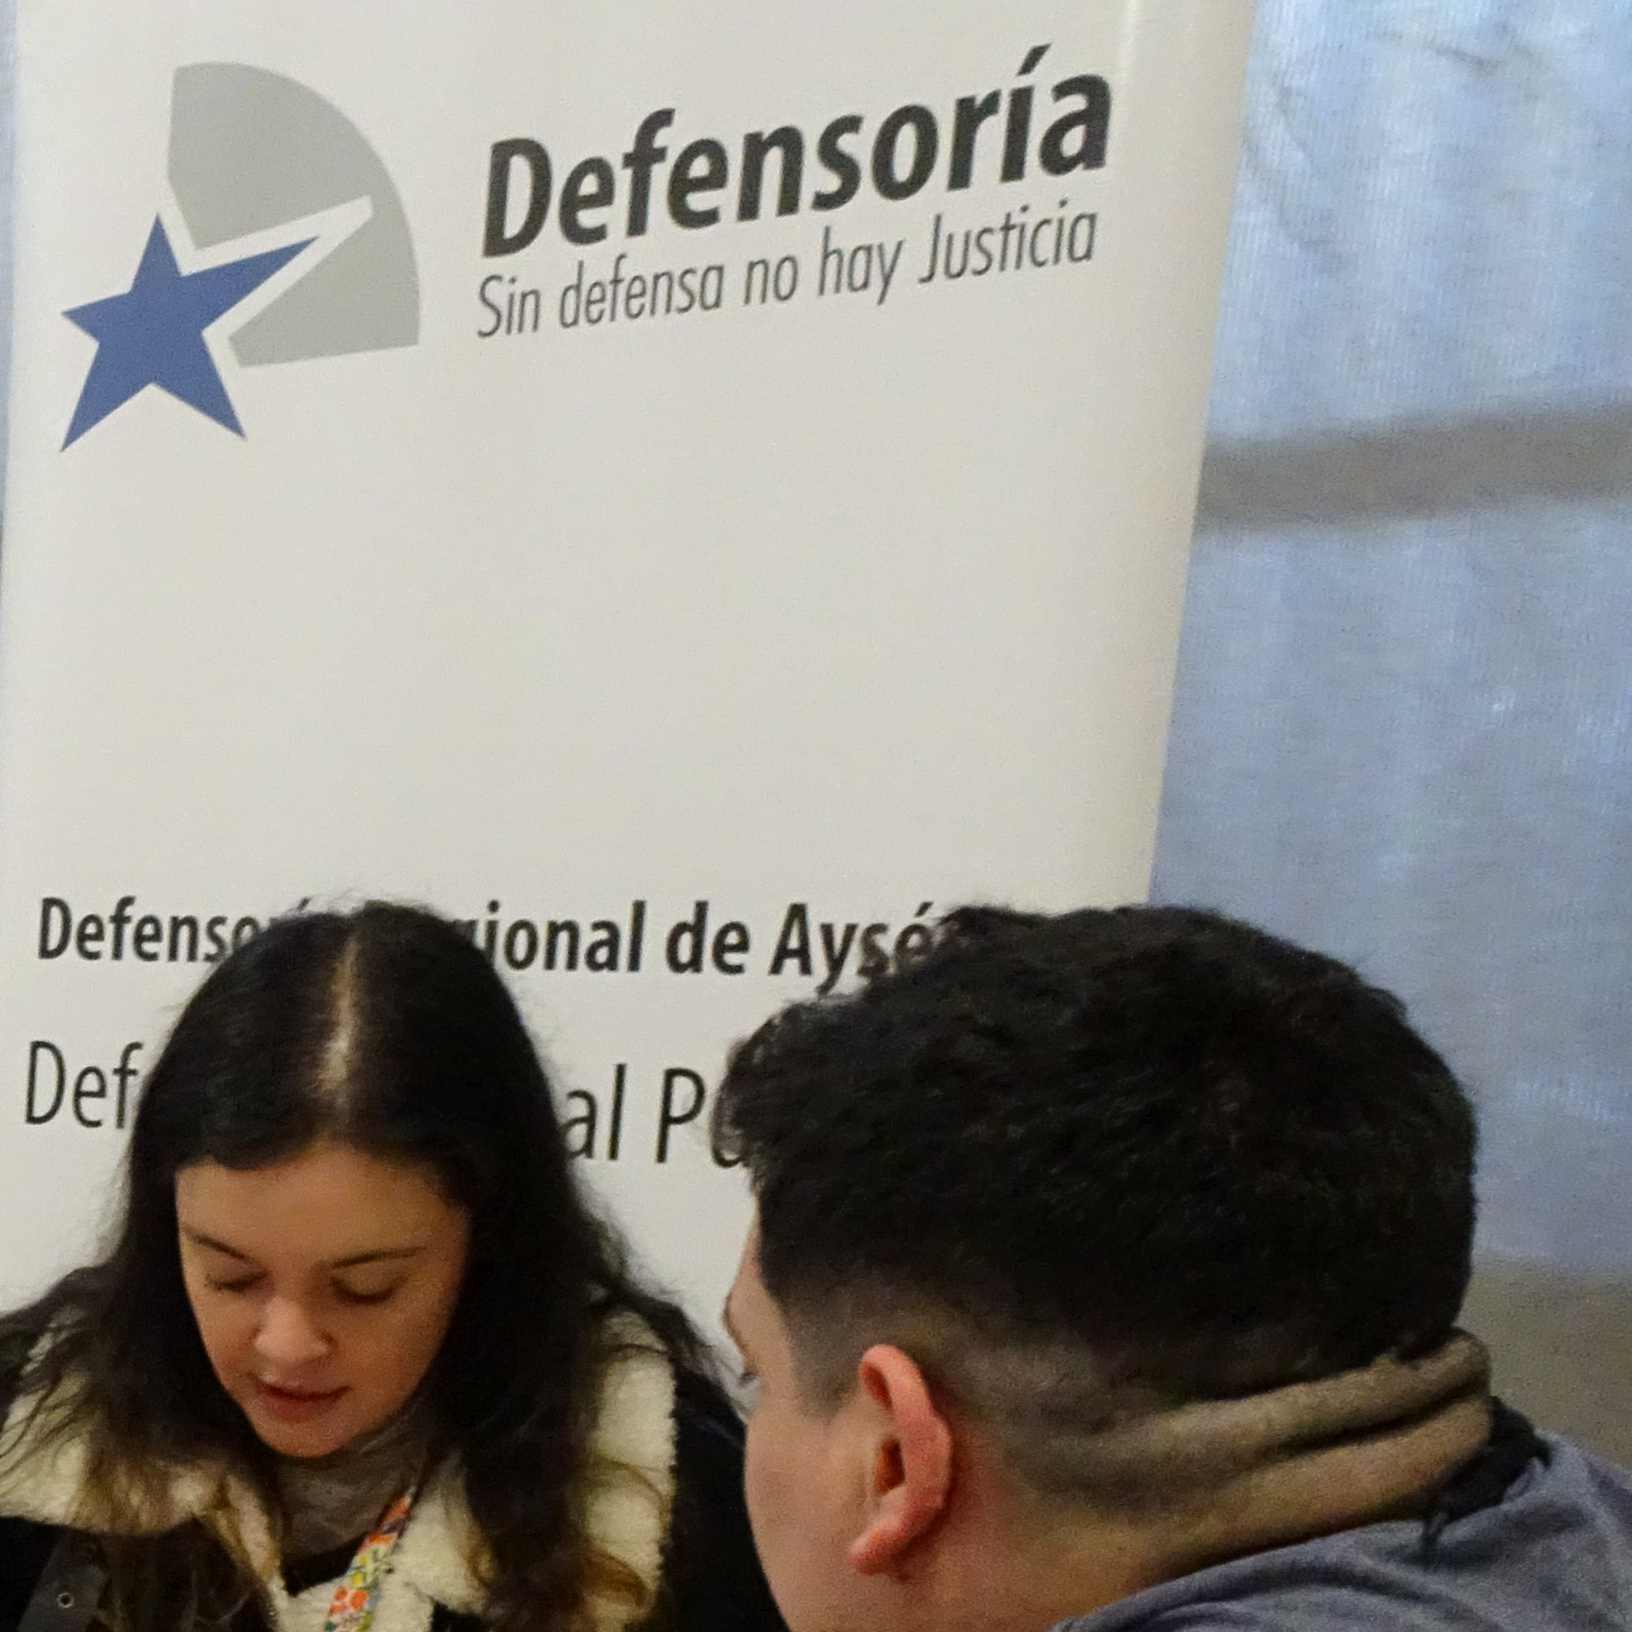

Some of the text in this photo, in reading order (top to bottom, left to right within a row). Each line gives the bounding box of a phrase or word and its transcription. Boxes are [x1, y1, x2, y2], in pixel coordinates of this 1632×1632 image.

[482, 43, 1113, 258] Defensoría
[477, 200, 1100, 339] Sin defensa no hay Justicia
[666, 900, 751, 974] de
[768, 901, 936, 997] Aysé
